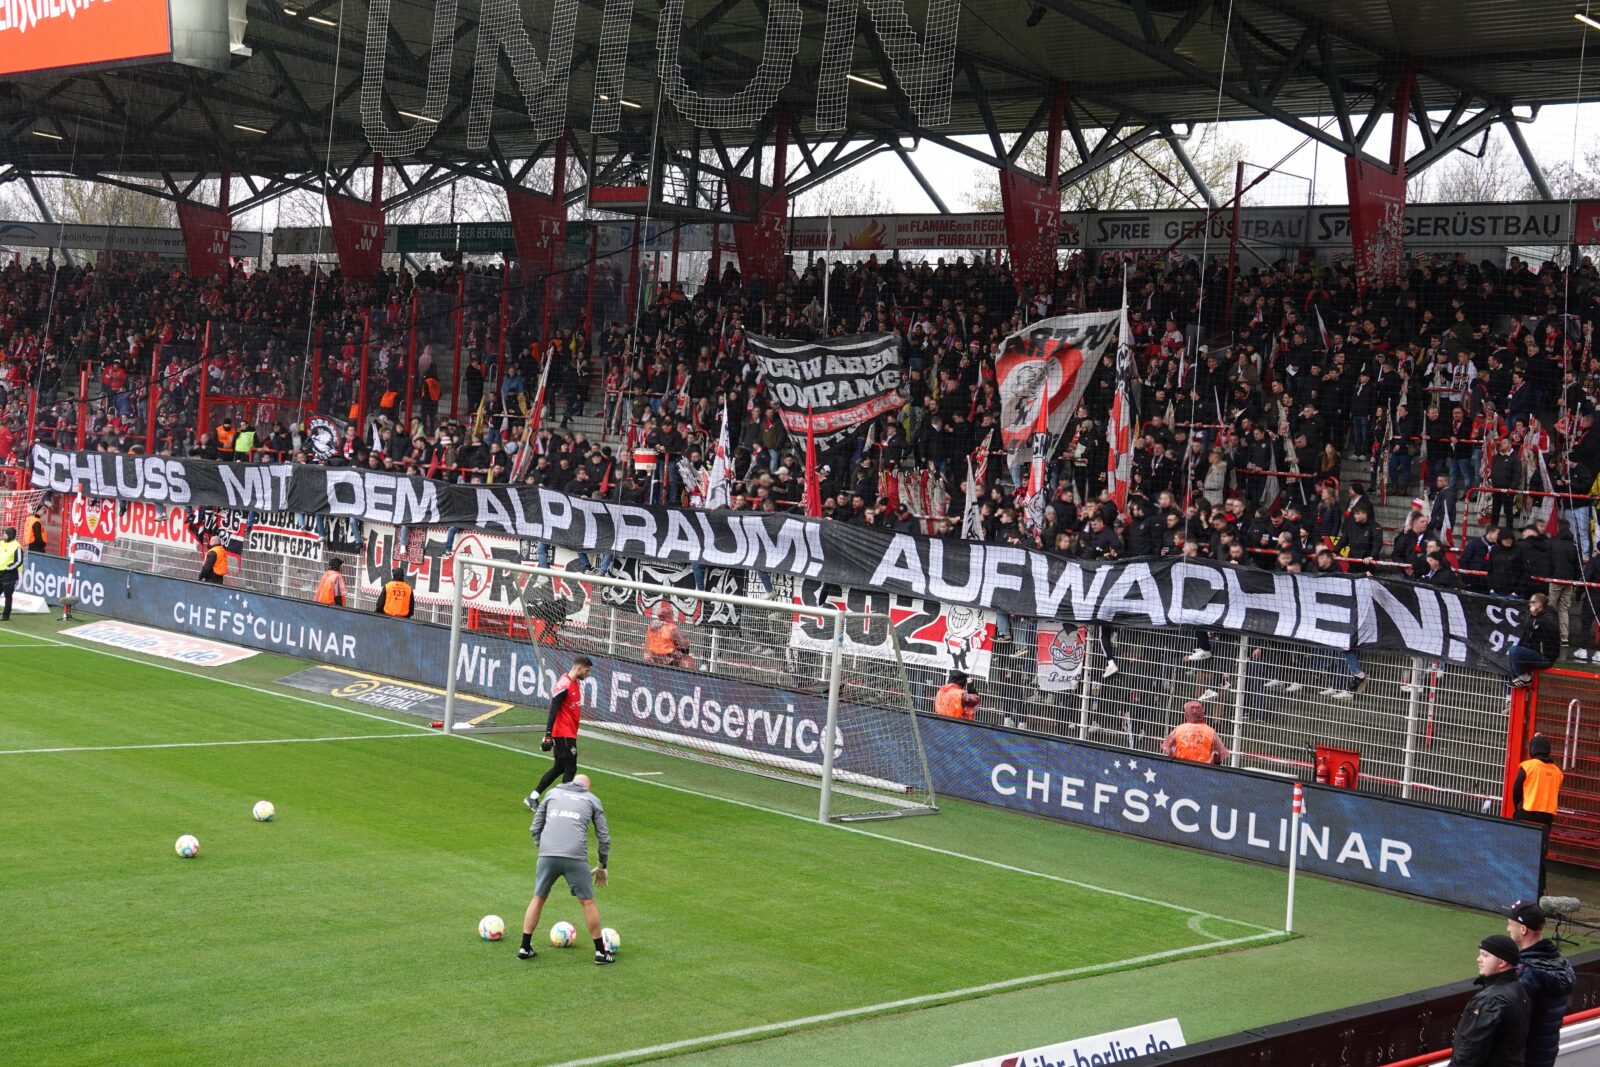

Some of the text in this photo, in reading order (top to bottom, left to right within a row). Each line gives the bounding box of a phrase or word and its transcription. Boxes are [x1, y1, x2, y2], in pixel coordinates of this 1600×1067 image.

[910, 219, 956, 232] FLAMME
[1097, 214, 1304, 243] SPREE GERÜSTBAU
[1403, 211, 1561, 238] GERÜSTBAU
[30, 443, 192, 502] SCHLUSS
[218, 464, 293, 511] MIT
[326, 470, 441, 524] DEM
[476, 488, 825, 576] ALPTRAUM!
[869, 532, 1469, 662] AUFWACHEN!
[250, 531, 322, 560] STUTTGART
[173, 601, 357, 659] CHEFS CULINAR
[356, 691, 418, 711] CENTRAL
[374, 684, 440, 702] COMEDY
[991, 762, 1414, 878] CHEFS CULINAR
